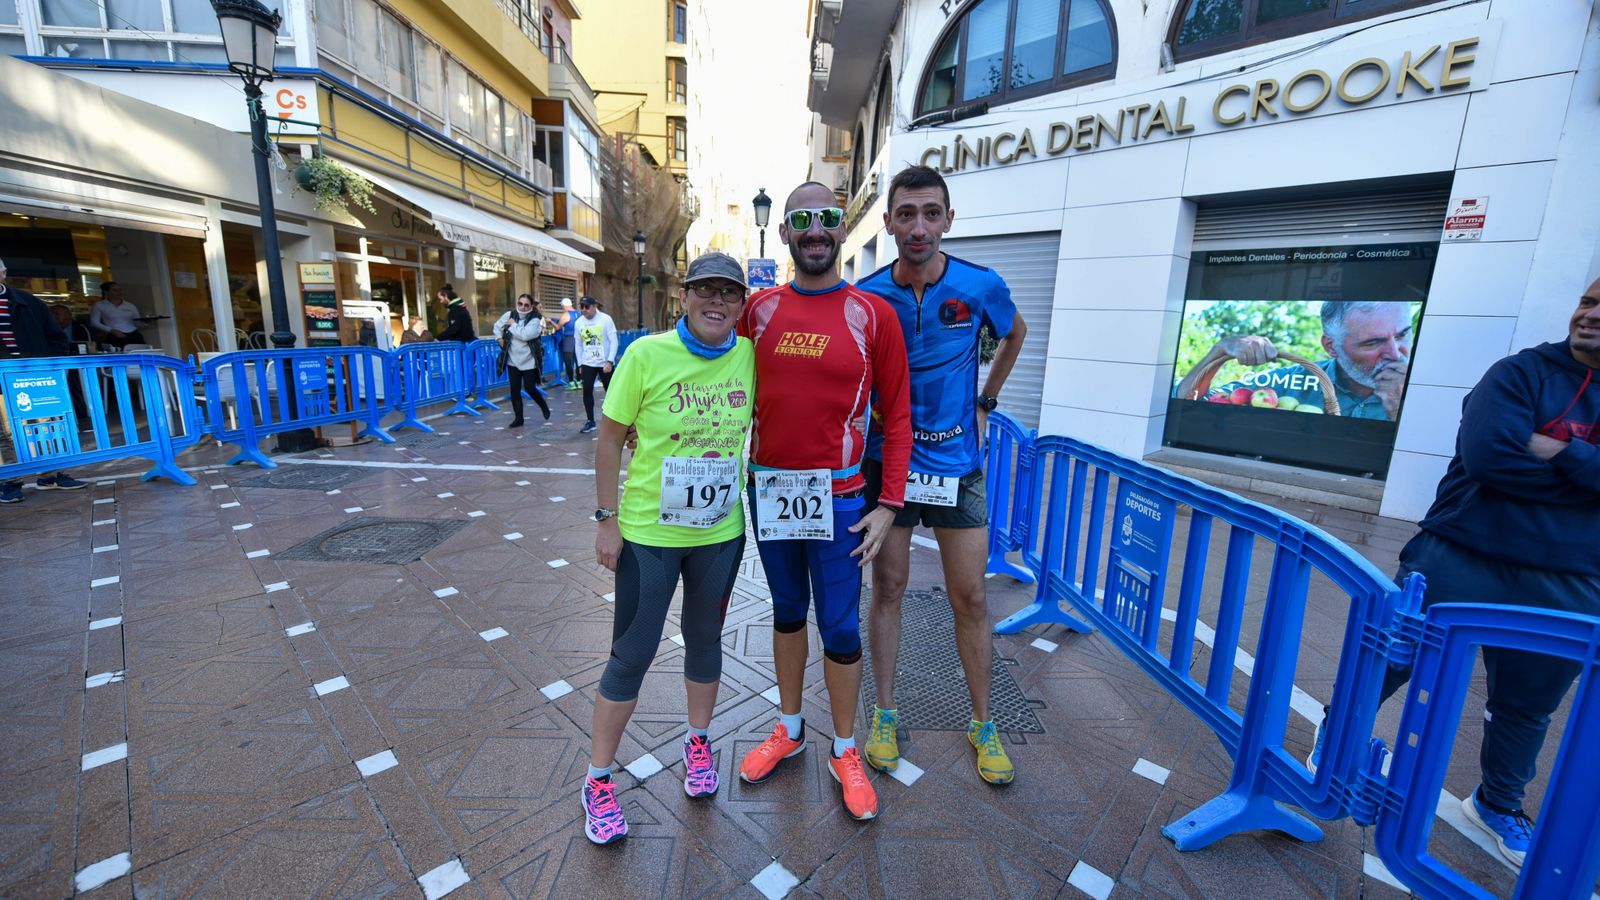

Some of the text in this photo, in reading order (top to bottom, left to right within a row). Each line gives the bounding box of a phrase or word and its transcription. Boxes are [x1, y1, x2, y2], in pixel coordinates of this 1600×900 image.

[276, 89, 307, 110] Cs
[919, 36, 1480, 173] CLÍNICA DENTAL CROOKE
[1447, 216, 1484, 224] Alarma
[1209, 254, 1247, 264] Implantes
[1248, 252, 1286, 263] Dentales
[1293, 251, 1348, 261] Periodoncia
[1356, 249, 1410, 259] Cosmética
[779, 332, 830, 349] HOLE!
[13, 379, 57, 389] DEPORTES
[725, 378, 734, 388] de
[735, 378, 744, 388] la
[1240, 371, 1320, 391] COMER
[685, 392, 726, 412] Mujer
[684, 484, 732, 508] 197
[776, 496, 824, 520] 202
[1125, 497, 1162, 521] DEPORTES
